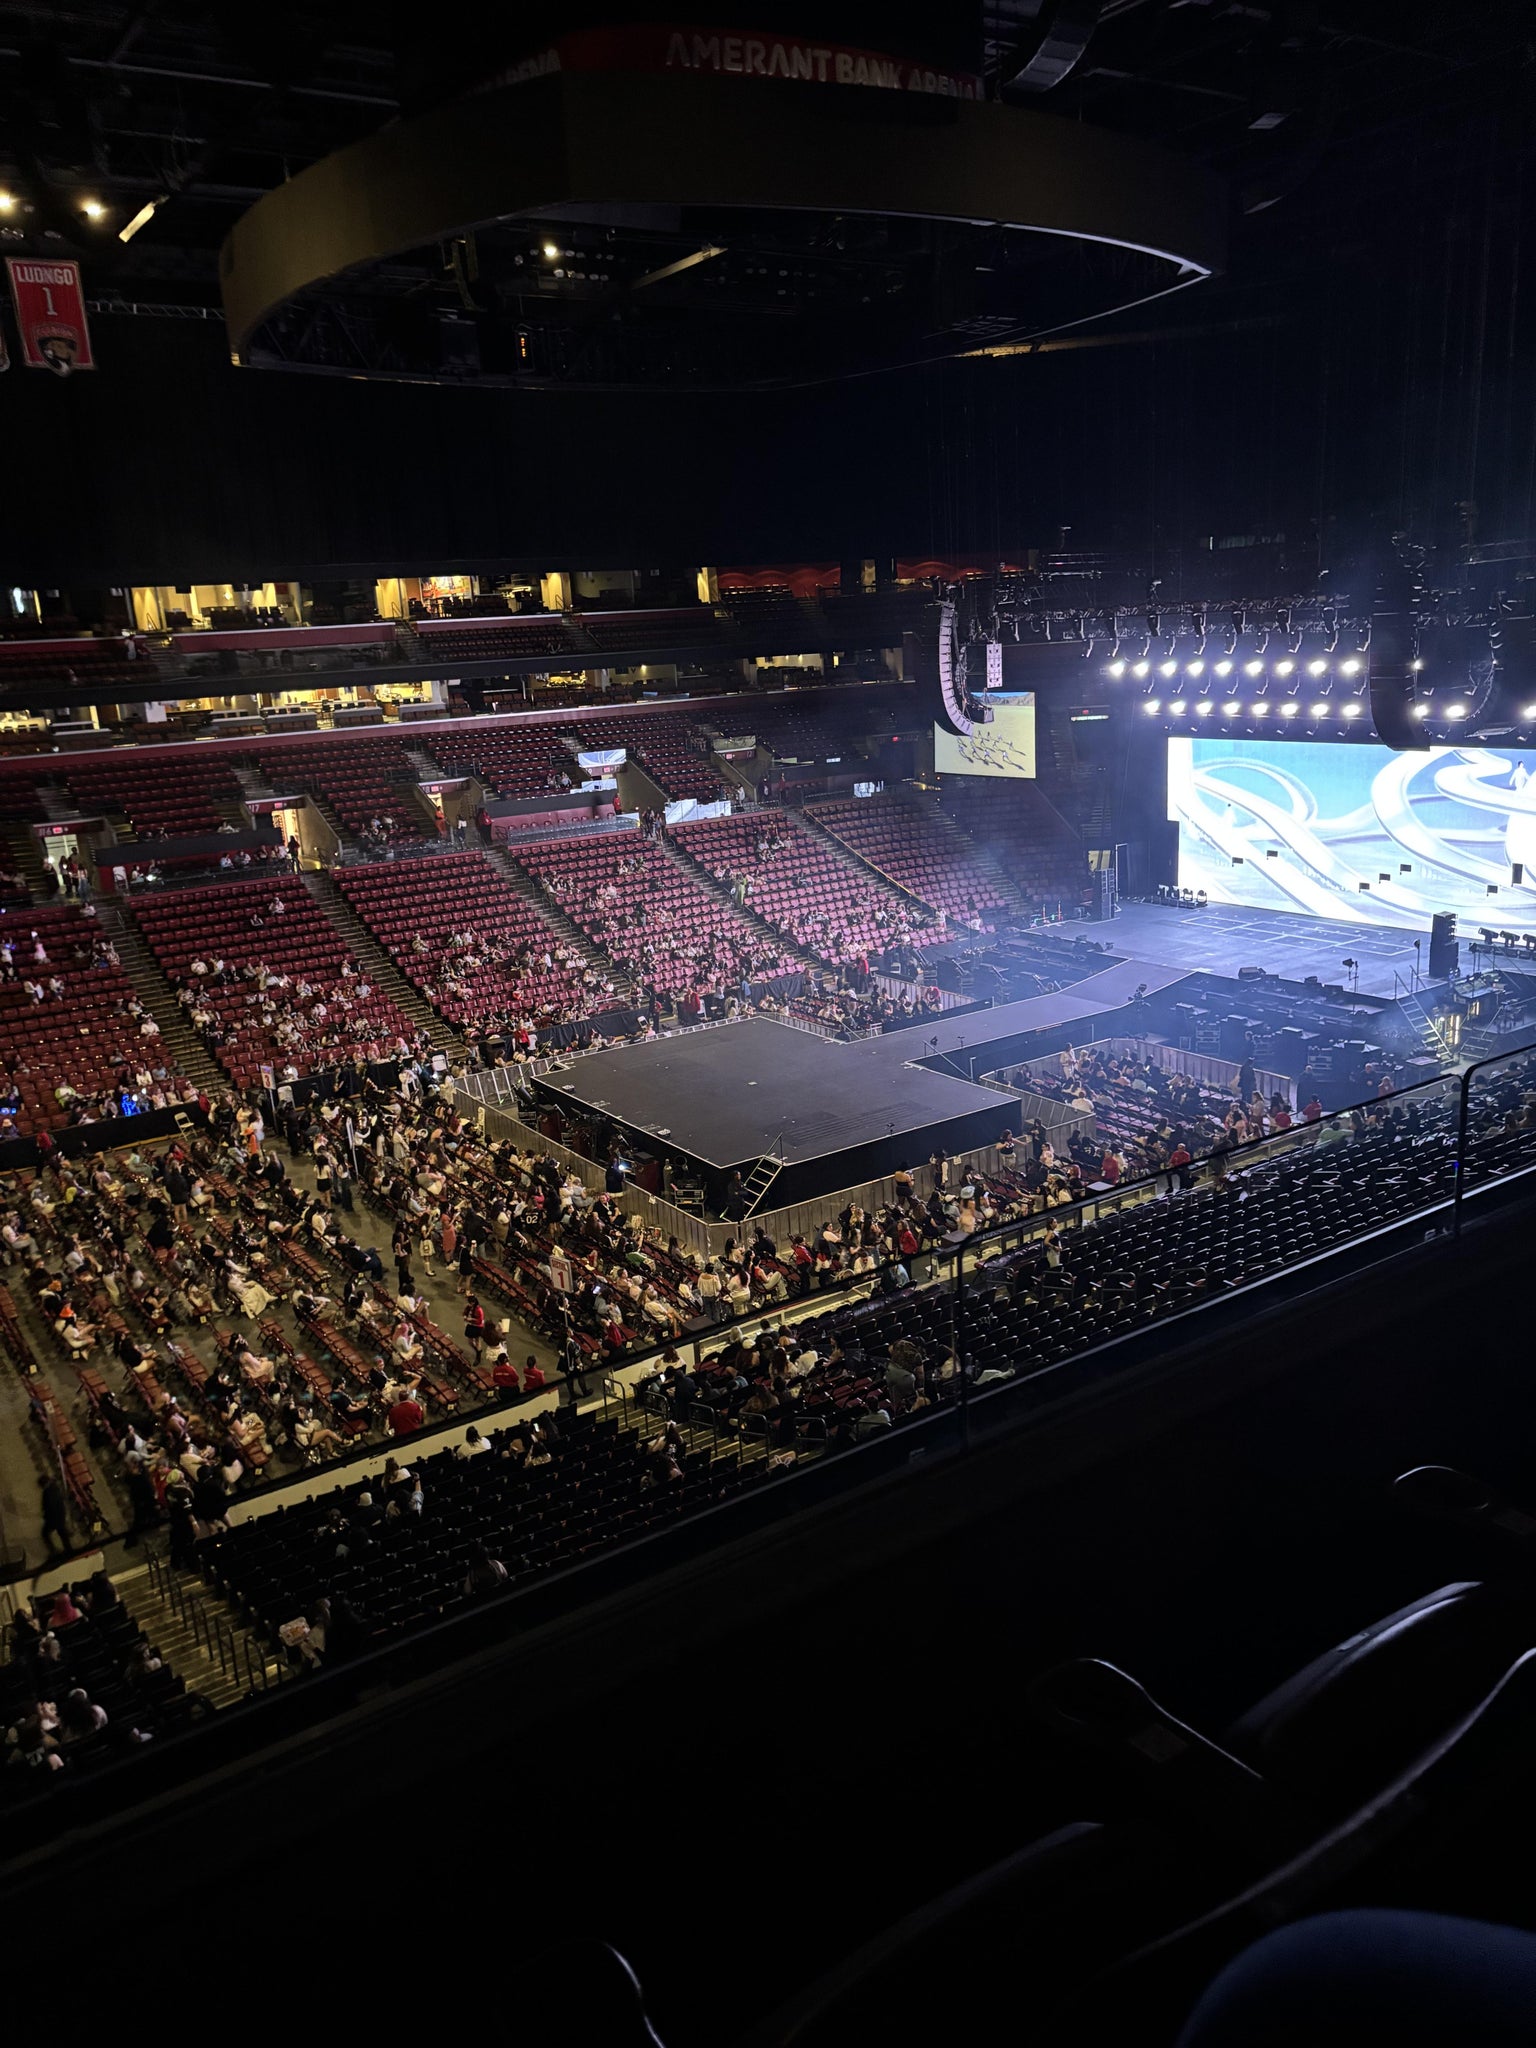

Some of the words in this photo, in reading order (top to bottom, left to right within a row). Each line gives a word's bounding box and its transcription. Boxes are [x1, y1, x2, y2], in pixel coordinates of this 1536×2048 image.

[665, 32, 832, 83] AMERANT
[835, 52, 902, 88] BANK
[15, 265, 74, 286] LUONGO
[42, 286, 58, 316] 1
[557, 1271, 565, 1288] 1
